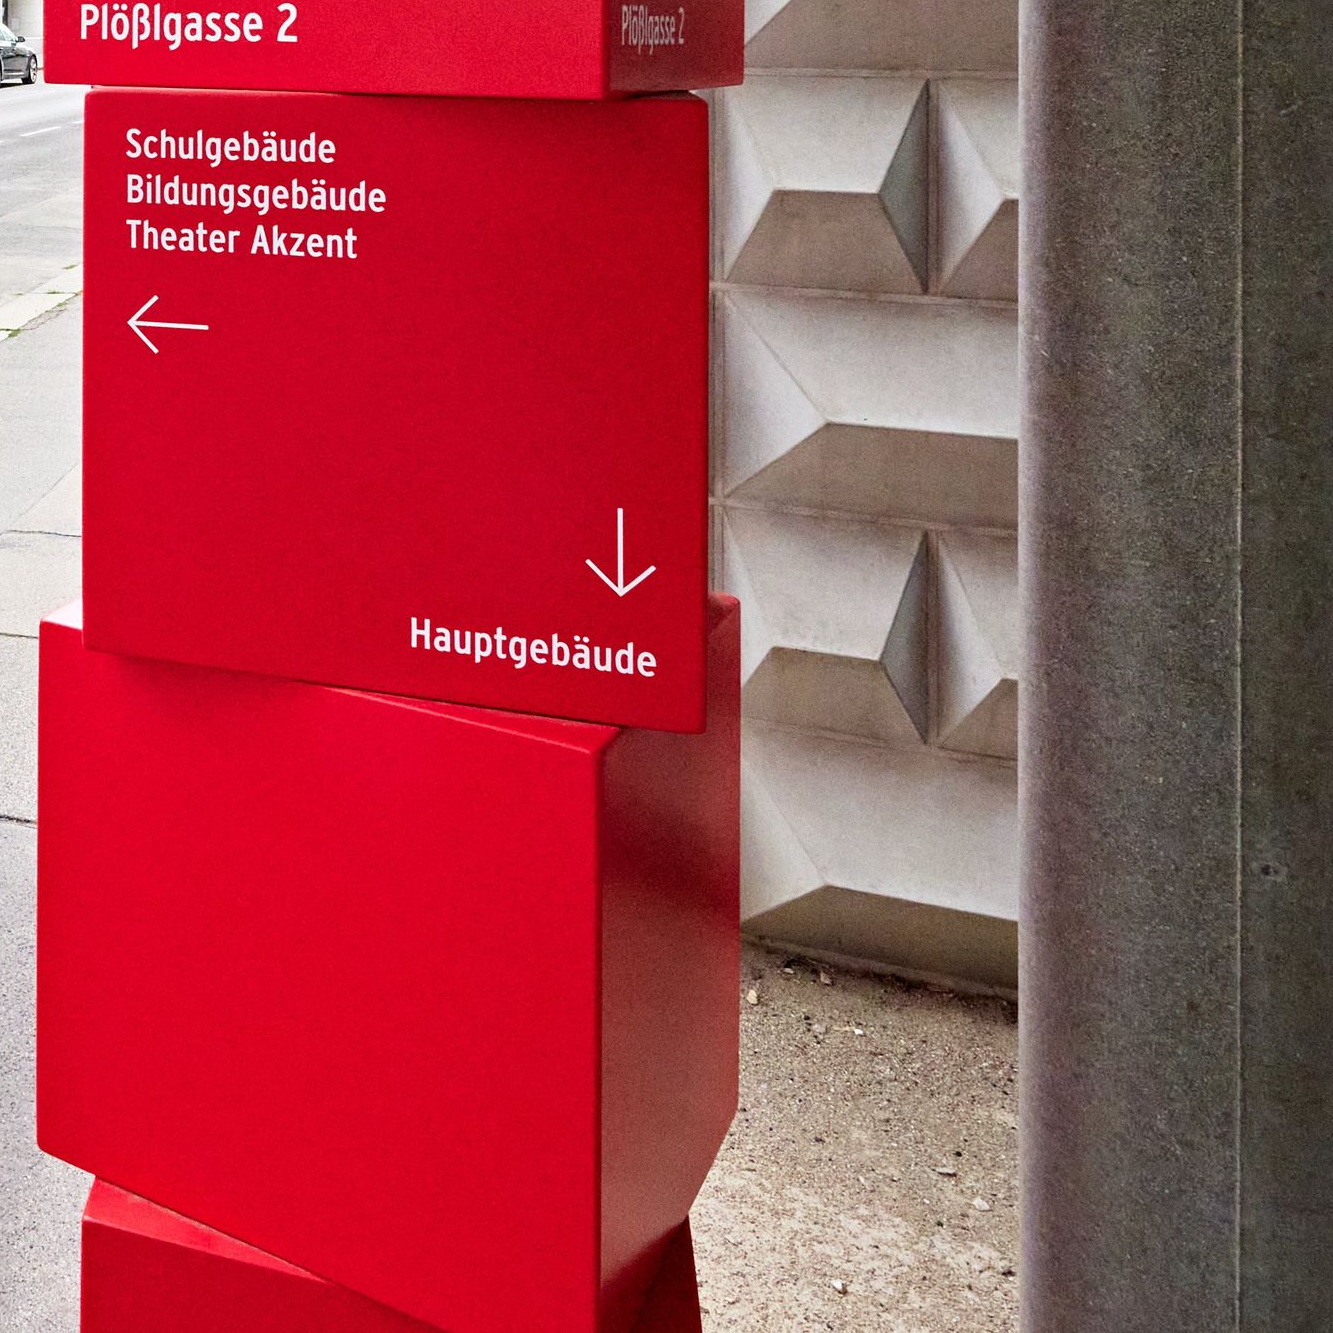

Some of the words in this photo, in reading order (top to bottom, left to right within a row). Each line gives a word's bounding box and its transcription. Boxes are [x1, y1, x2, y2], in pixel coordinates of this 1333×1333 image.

[80, 3, 263, 50] Plößlgasse
[276, 3, 298, 43] 2
[621, 4, 676, 55] Plößlgasse
[678, 6, 685, 45] 2
[125, 128, 336, 168] Schulgebäude
[126, 174, 387, 215] Bildungsgebäude
[126, 219, 240, 255] Theater
[250, 224, 358, 259] Akzent
[409, 616, 657, 679] Hauptgebäude
